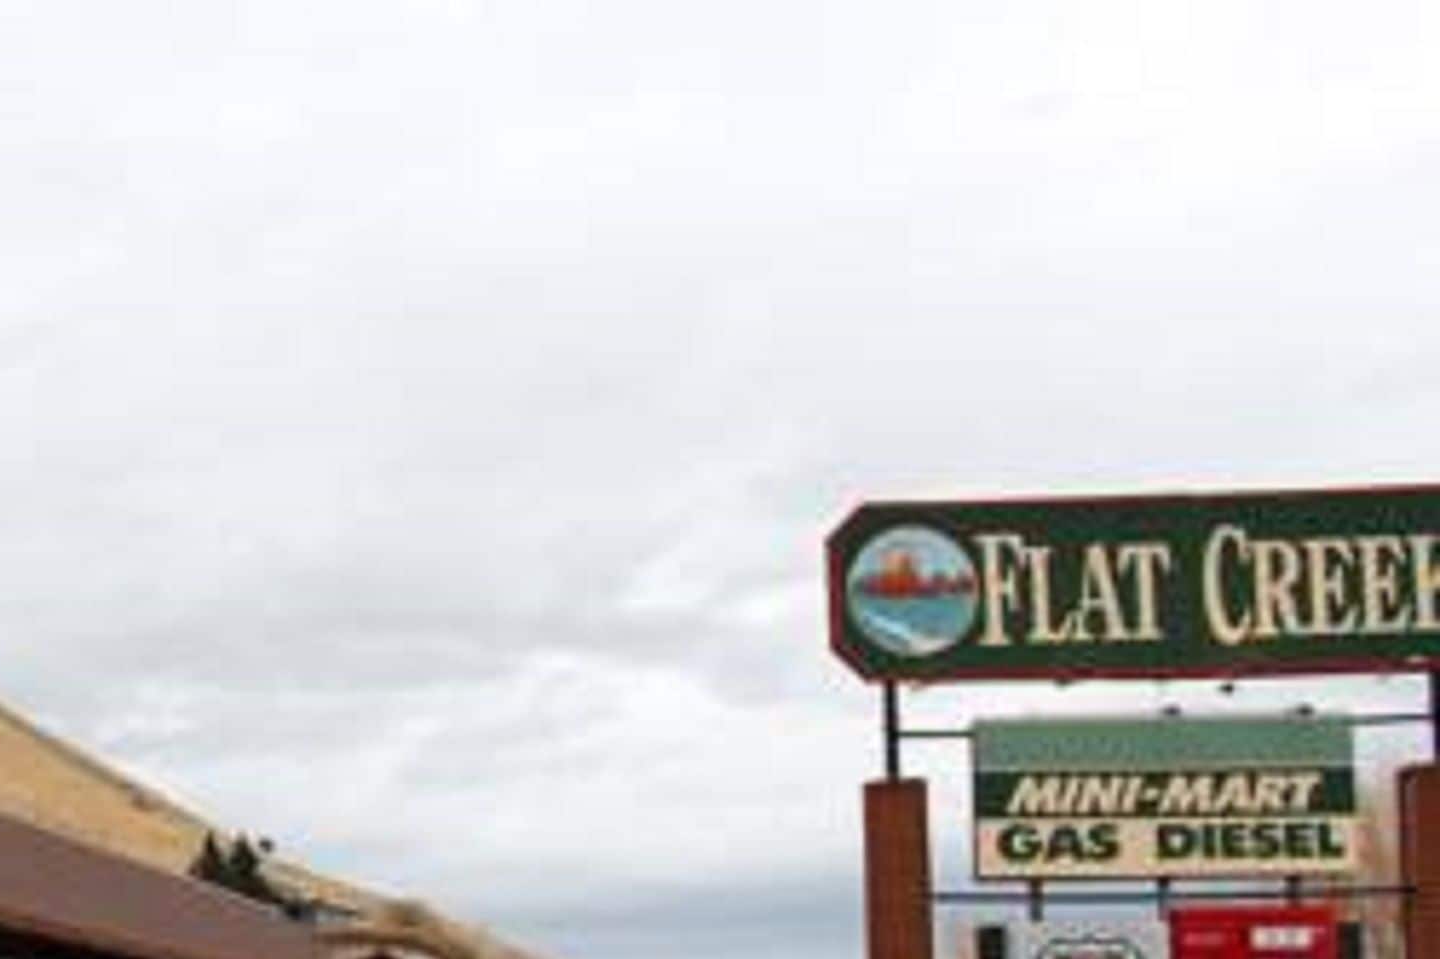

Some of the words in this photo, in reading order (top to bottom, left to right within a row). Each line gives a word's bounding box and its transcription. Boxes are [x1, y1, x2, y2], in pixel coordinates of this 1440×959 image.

[973, 533, 1169, 645] FLAT
[1007, 774, 1321, 814] MINI-MART
[997, 823, 1120, 861] GAS
[1157, 823, 1344, 860] DIESEL
